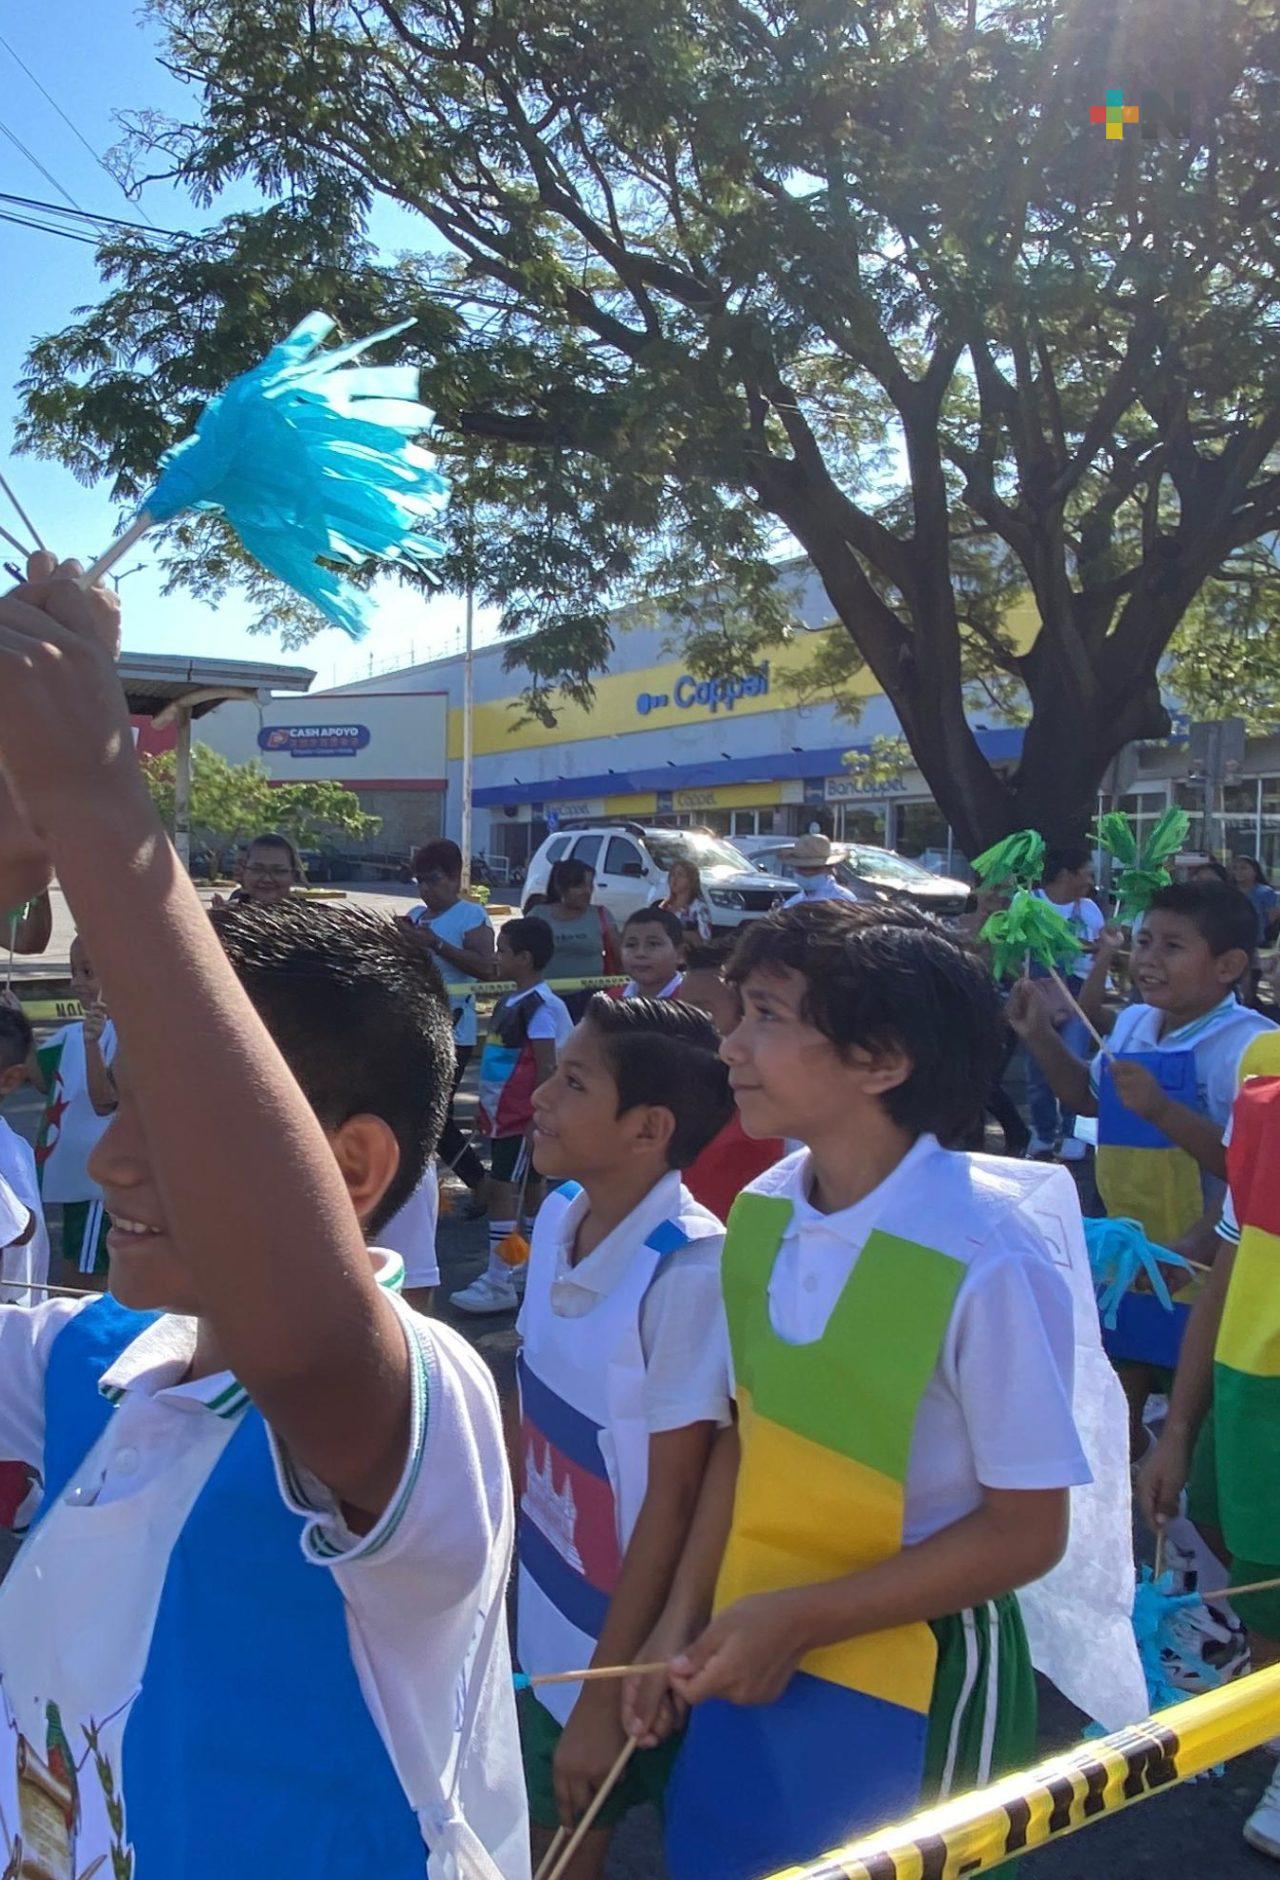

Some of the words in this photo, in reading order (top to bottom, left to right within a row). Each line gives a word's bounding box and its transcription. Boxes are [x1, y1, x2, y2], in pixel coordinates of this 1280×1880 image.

[674, 659, 770, 713] Coppel
[289, 728, 320, 738] CASH
[321, 727, 359, 737] APOYO
